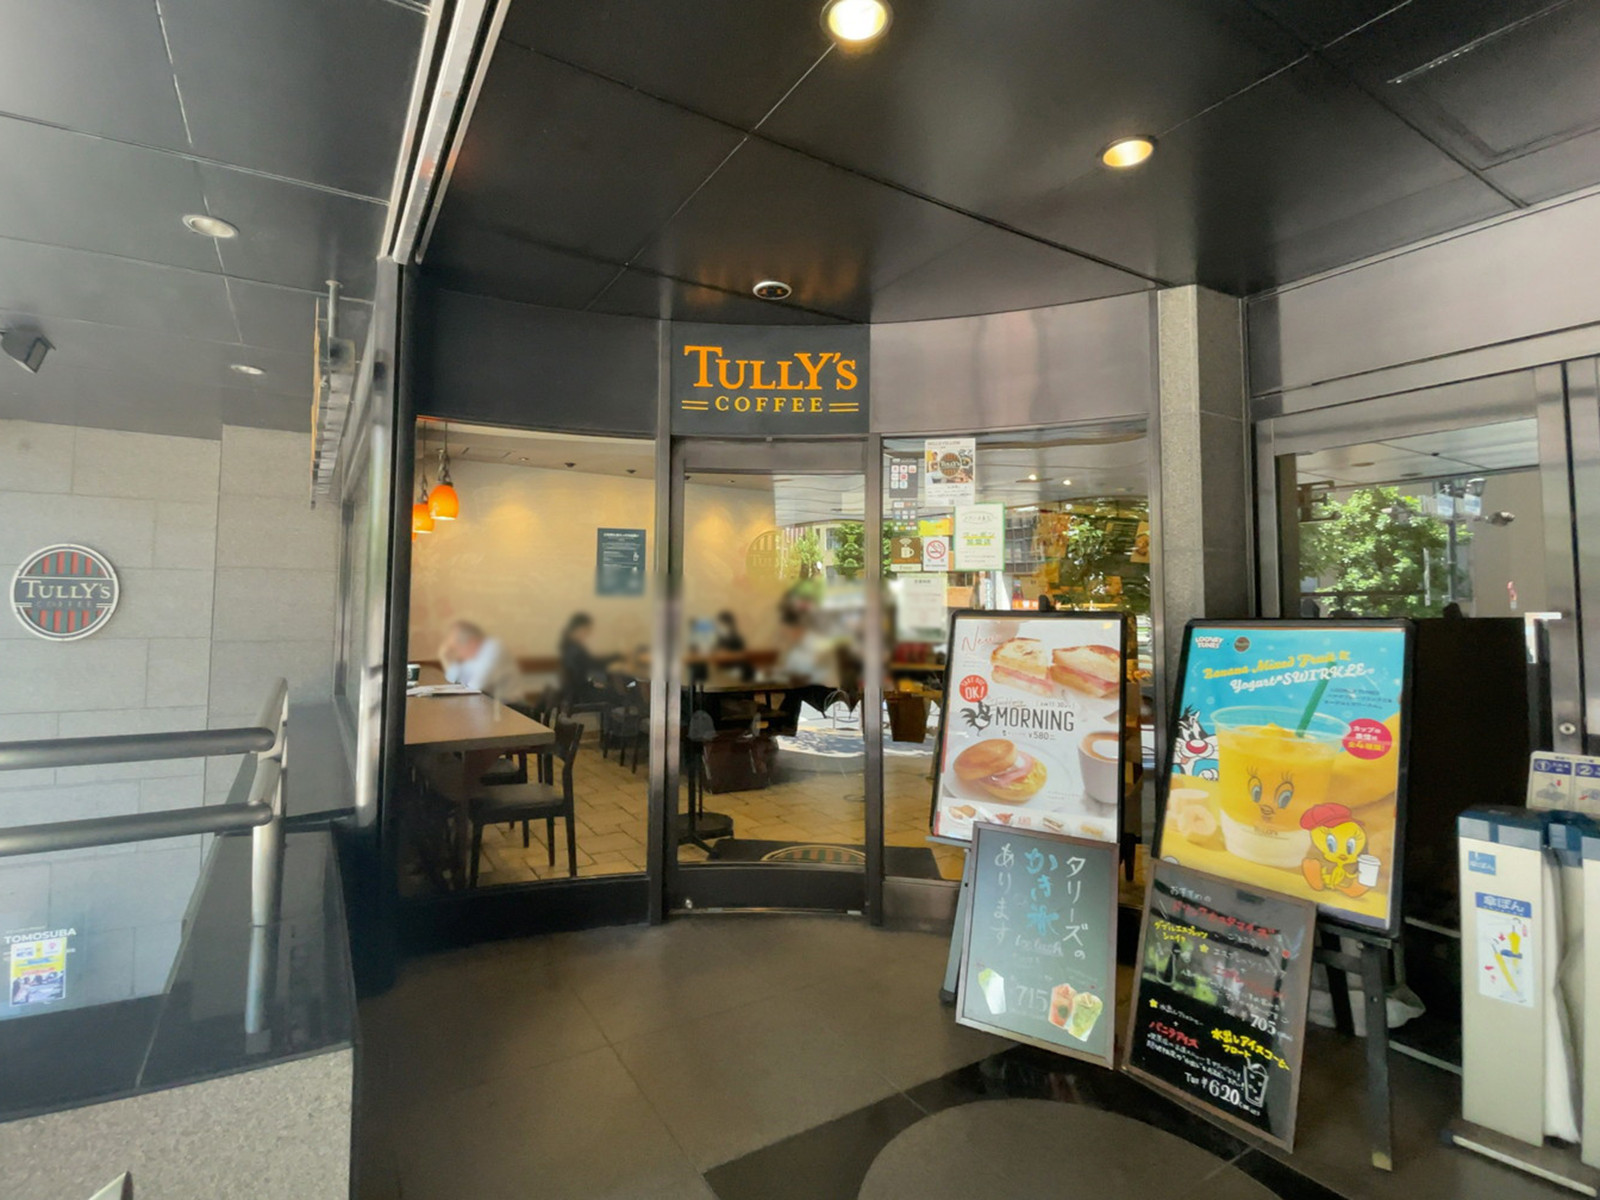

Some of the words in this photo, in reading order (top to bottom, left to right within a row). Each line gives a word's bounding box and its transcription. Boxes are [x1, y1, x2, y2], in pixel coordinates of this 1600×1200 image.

[684, 345, 858, 390] TULLY'S
[715, 396, 823, 412] COFFEE
[21, 580, 111, 599] TULLY'S
[1203, 666, 1249, 679] Banana
[1252, 656, 1295, 673] Mixed
[965, 686, 985, 699] OK!
[995, 706, 1074, 732] MORNING
[992, 843, 1015, 945] あります
[1063, 857, 1088, 960] タリーズの
[3, 927, 77, 944] TOMOSUBA
[1222, 1044, 1252, 1058] フロート
